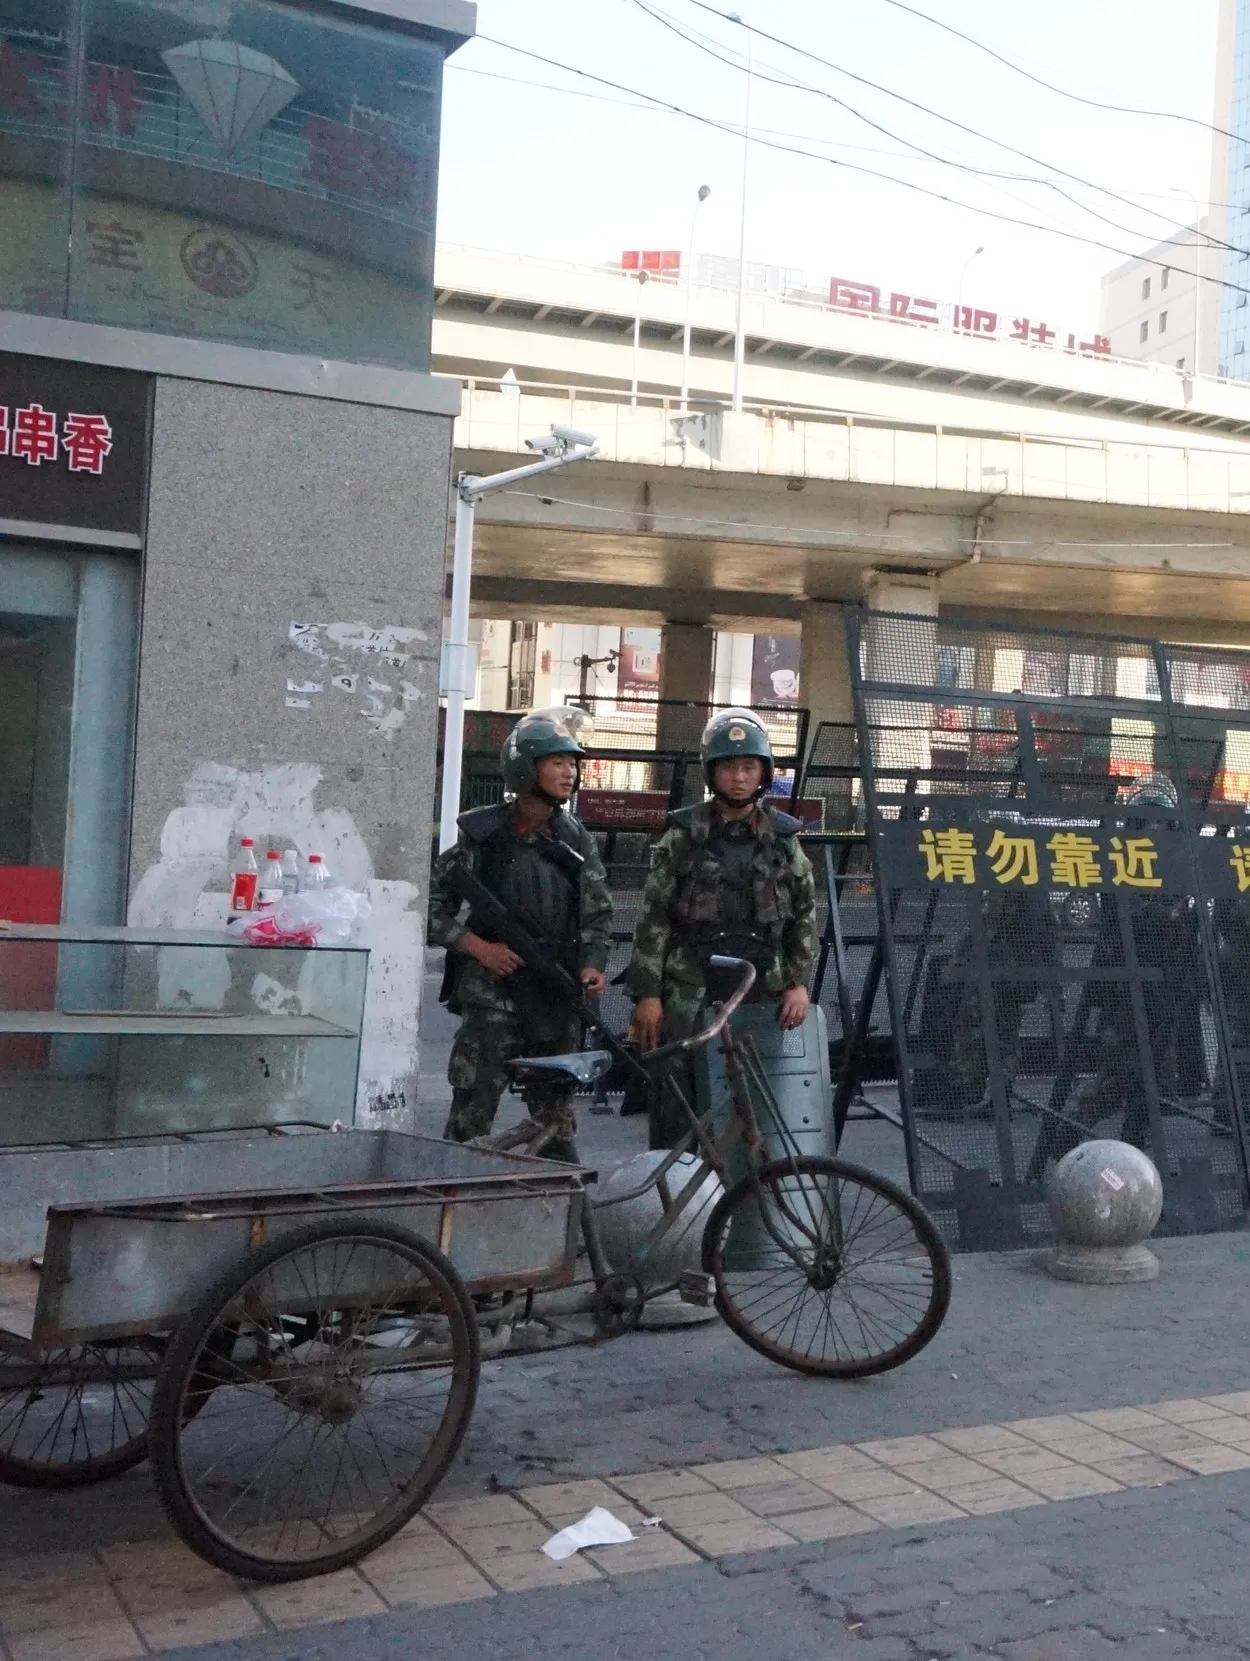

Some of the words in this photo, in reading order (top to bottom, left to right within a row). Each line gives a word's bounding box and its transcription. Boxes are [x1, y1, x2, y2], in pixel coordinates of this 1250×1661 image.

[0, 404, 113, 475] 串香
[918, 828, 1163, 888] 请勿靠近
